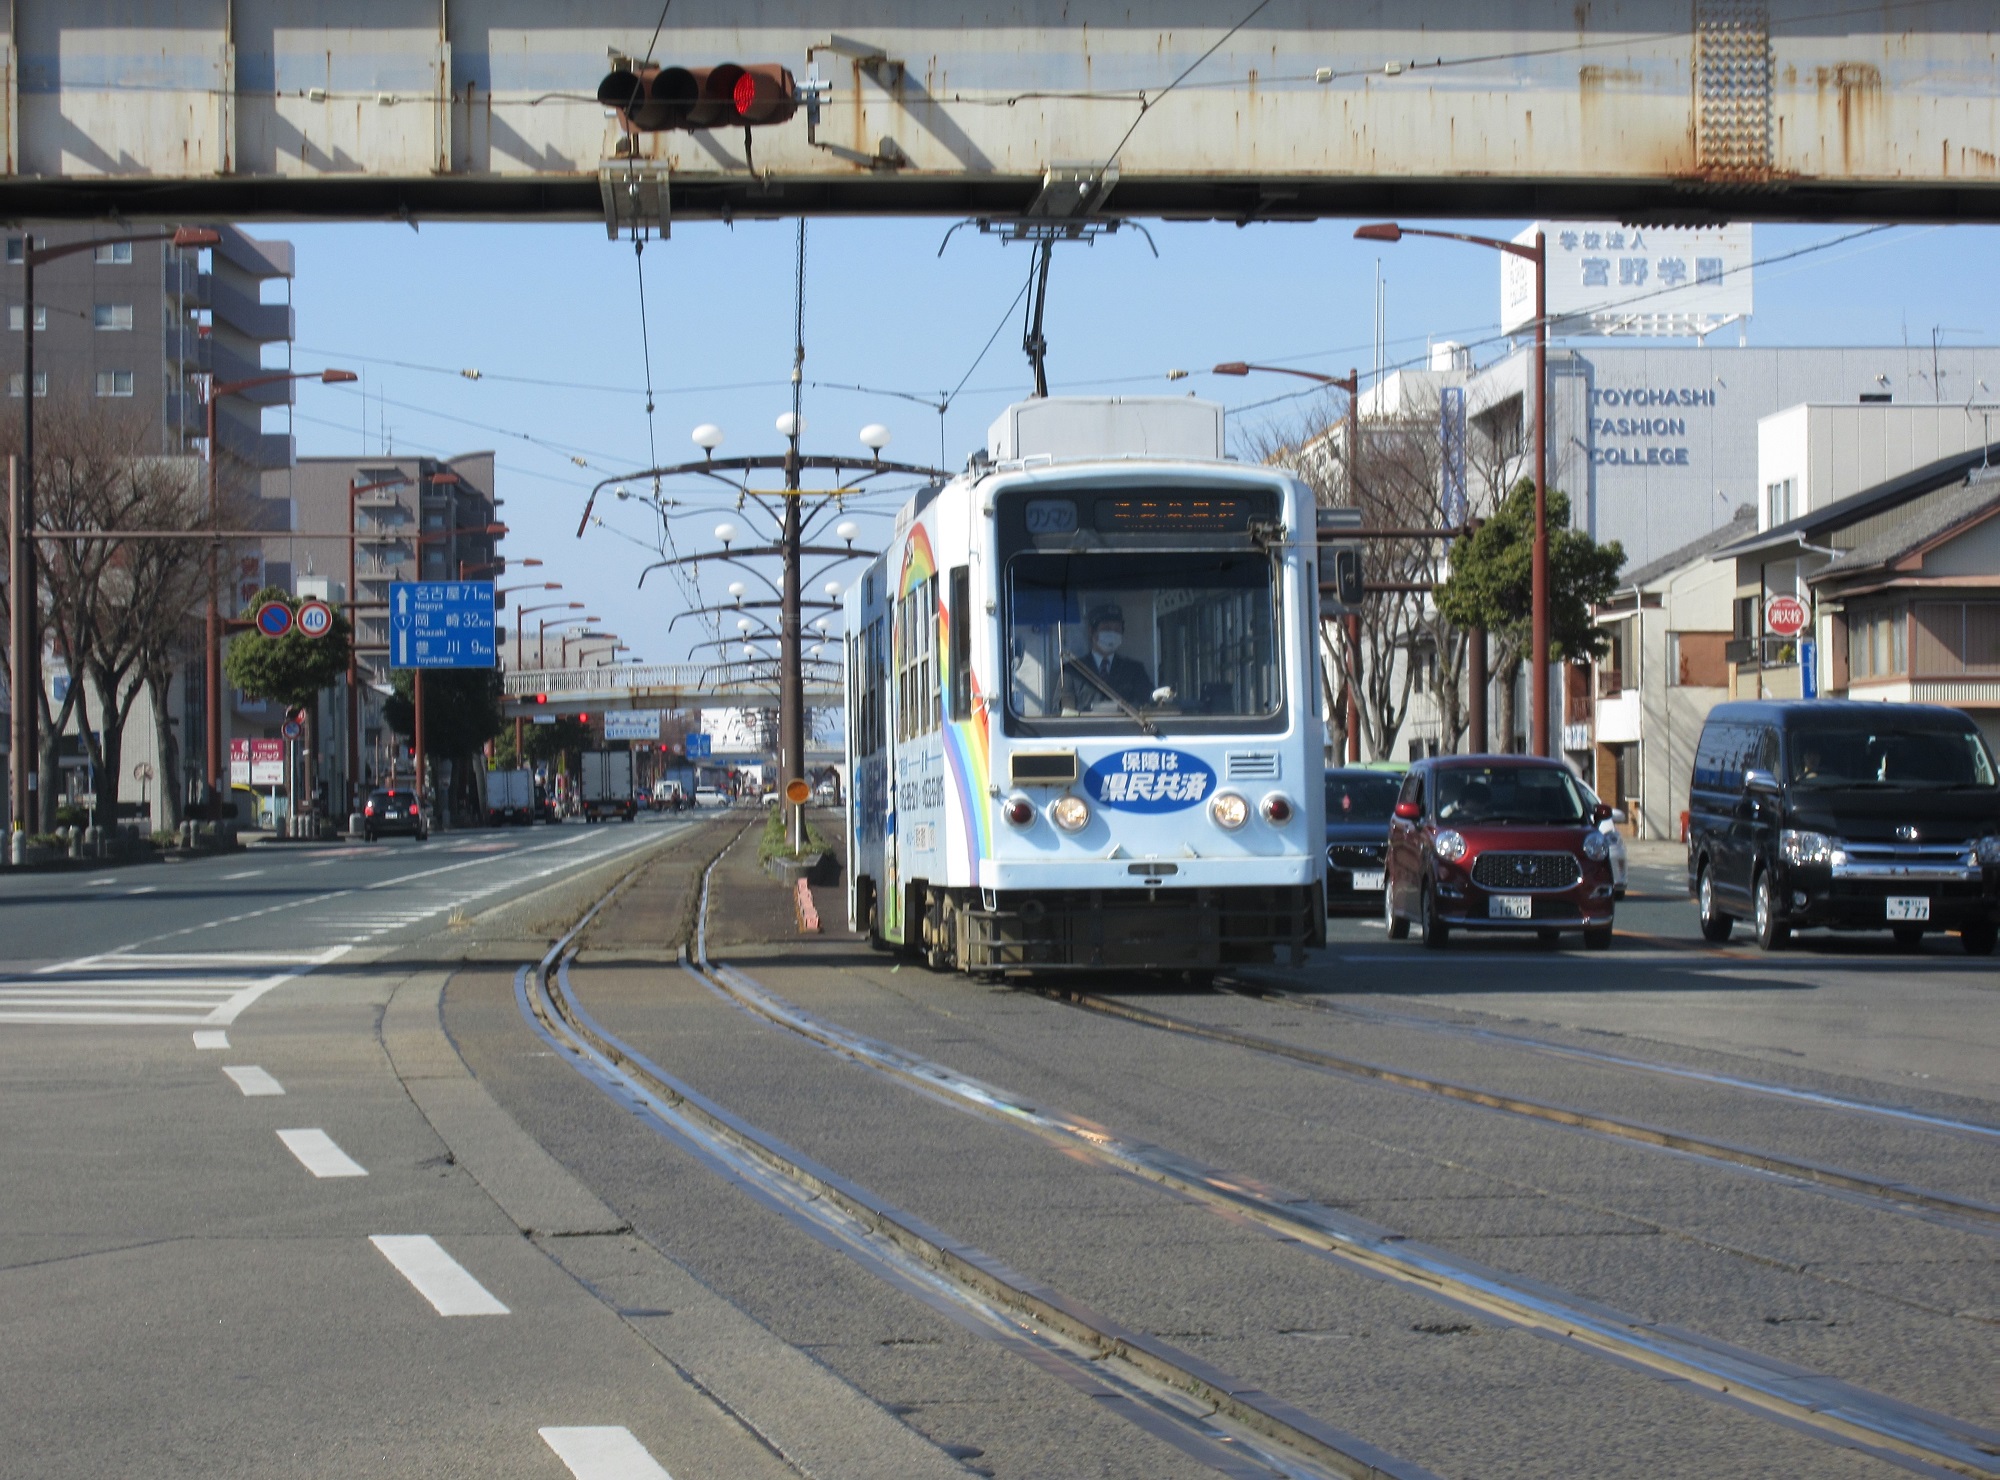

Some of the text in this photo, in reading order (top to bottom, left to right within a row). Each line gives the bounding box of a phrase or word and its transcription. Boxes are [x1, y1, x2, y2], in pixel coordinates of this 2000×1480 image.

[1558, 229, 1648, 251] 学校法人
[1588, 388, 1716, 407] TOYOHASHI
[1590, 417, 1686, 436] FASHION
[1590, 447, 1690, 465] COLLEGE
[415, 585, 460, 601] 名古屋
[414, 601, 444, 611] Nagoya
[305, 611, 324, 628] 40
[400, 616, 406, 627] 1
[1771, 608, 1801, 625] 消火栓
[415, 628, 447, 638] Okazaki
[416, 656, 454, 665] Toyokawa
[1122, 752, 1178, 772] 保障は
[1101, 773, 1207, 801] 県民共済
